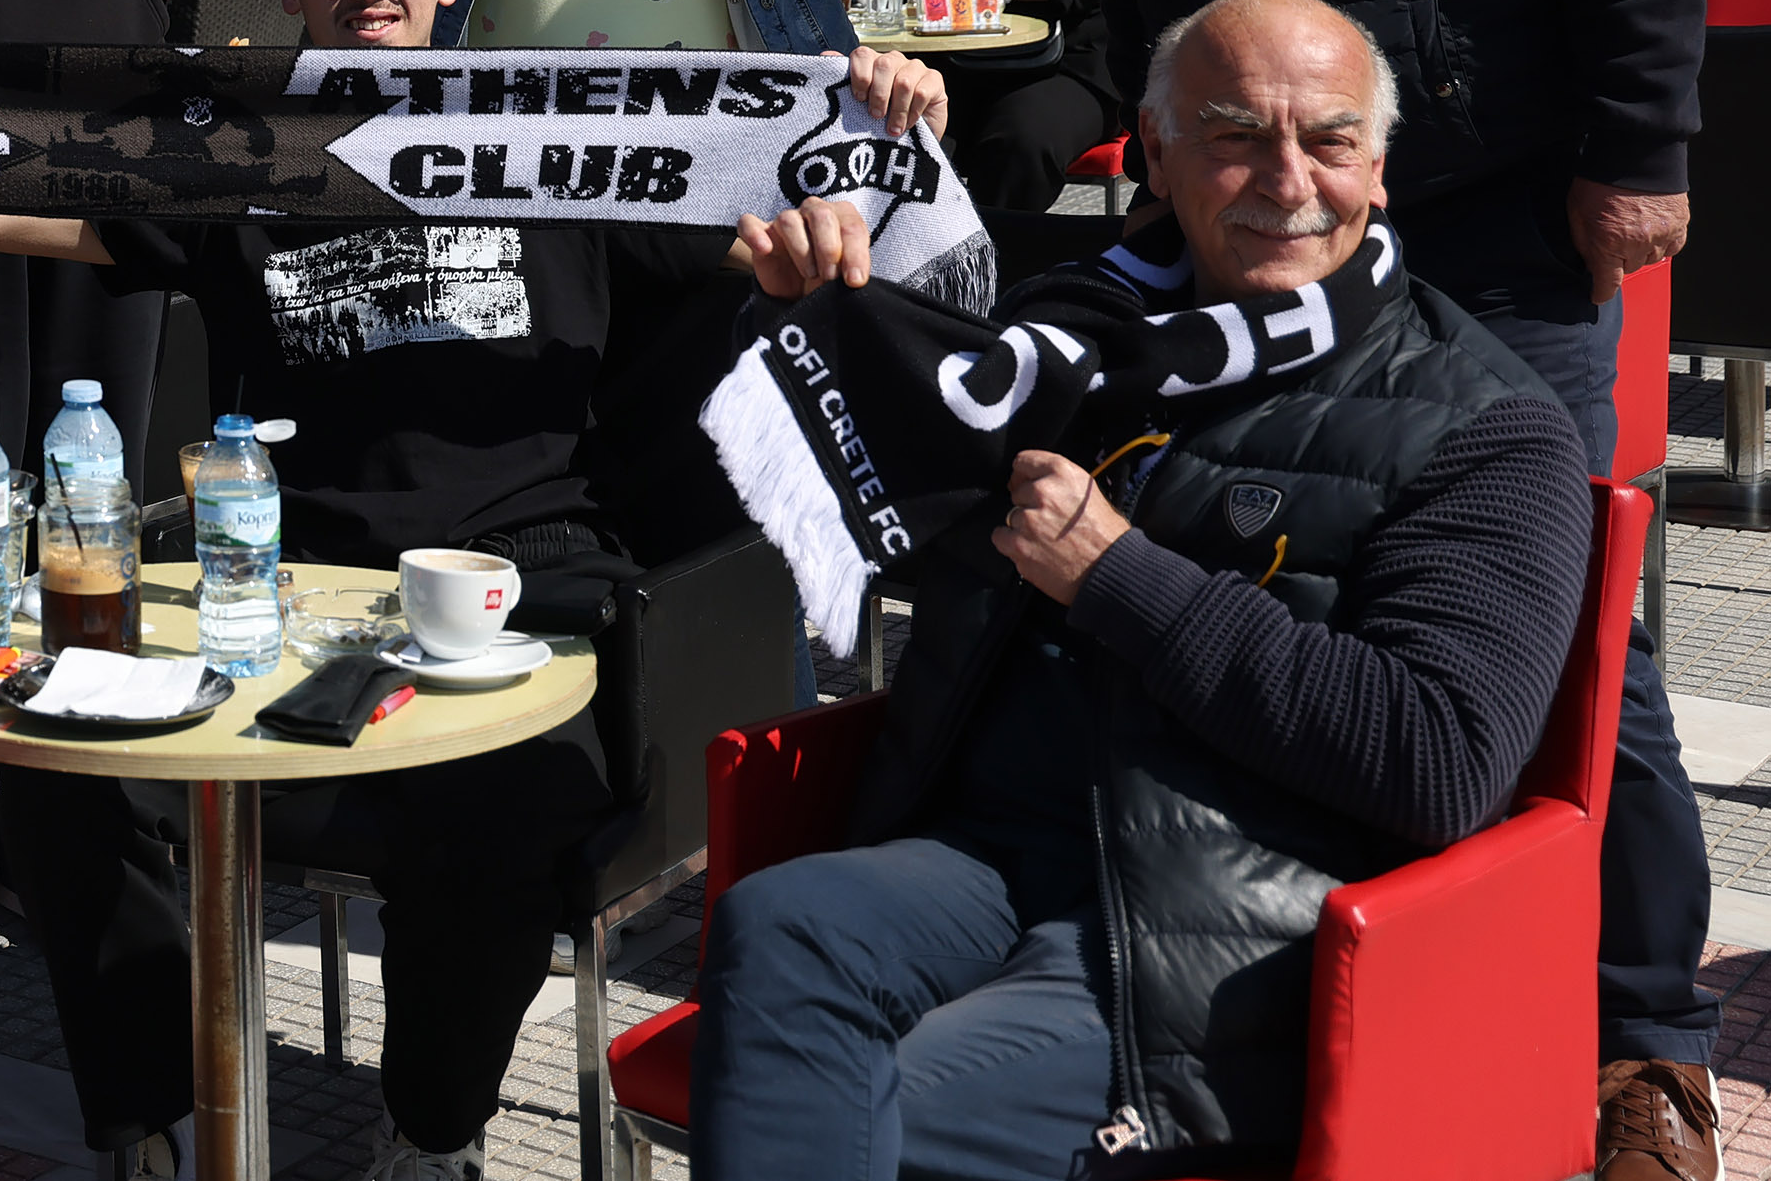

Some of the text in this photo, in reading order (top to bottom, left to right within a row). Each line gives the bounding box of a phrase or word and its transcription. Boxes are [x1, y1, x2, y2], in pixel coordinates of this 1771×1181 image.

[308, 67, 812, 117] ATHENS
[390, 144, 695, 204] CLUB
[778, 323, 912, 556] OFI CRETE FC
